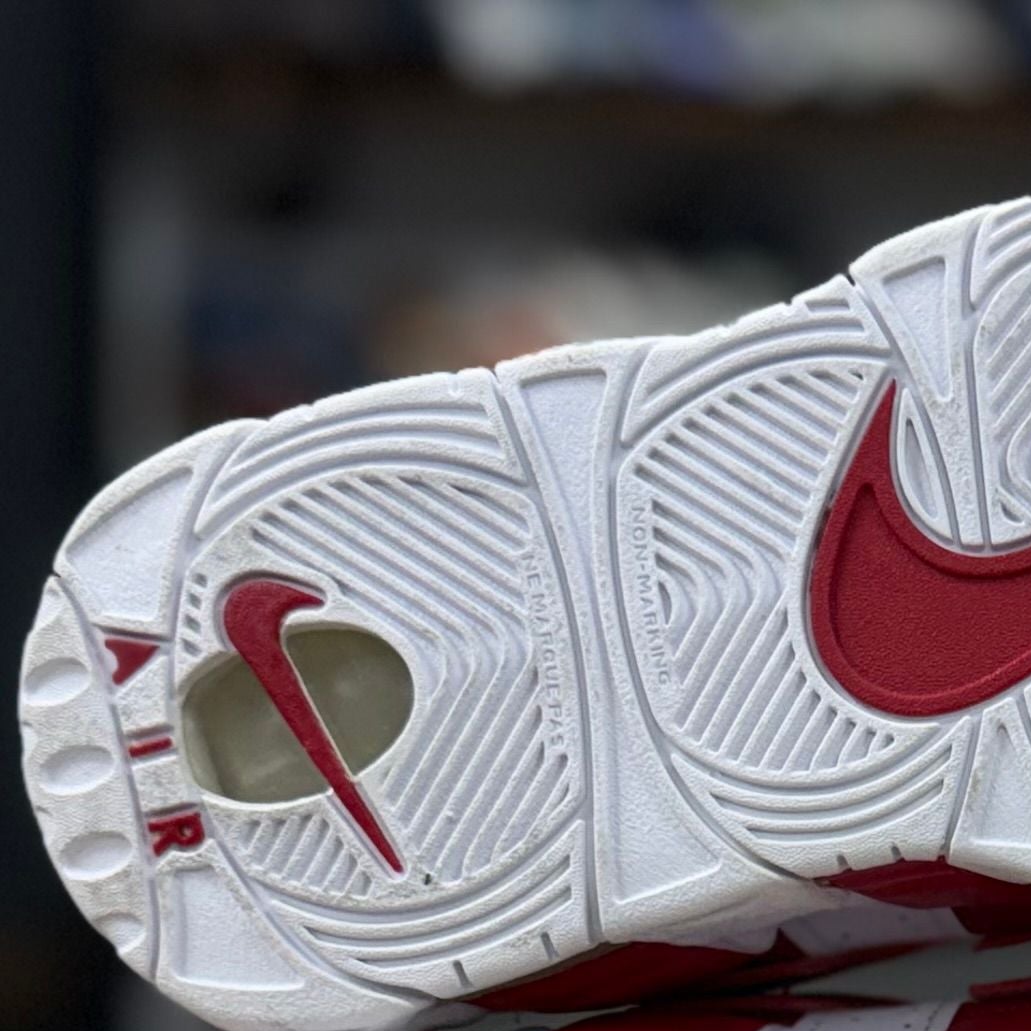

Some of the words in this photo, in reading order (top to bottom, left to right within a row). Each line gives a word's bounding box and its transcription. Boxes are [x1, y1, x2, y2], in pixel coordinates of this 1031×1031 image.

[631, 506, 670, 685] NON-MARKING
[104, 638, 206, 858] AIR
[548, 703, 565, 747] PAS
